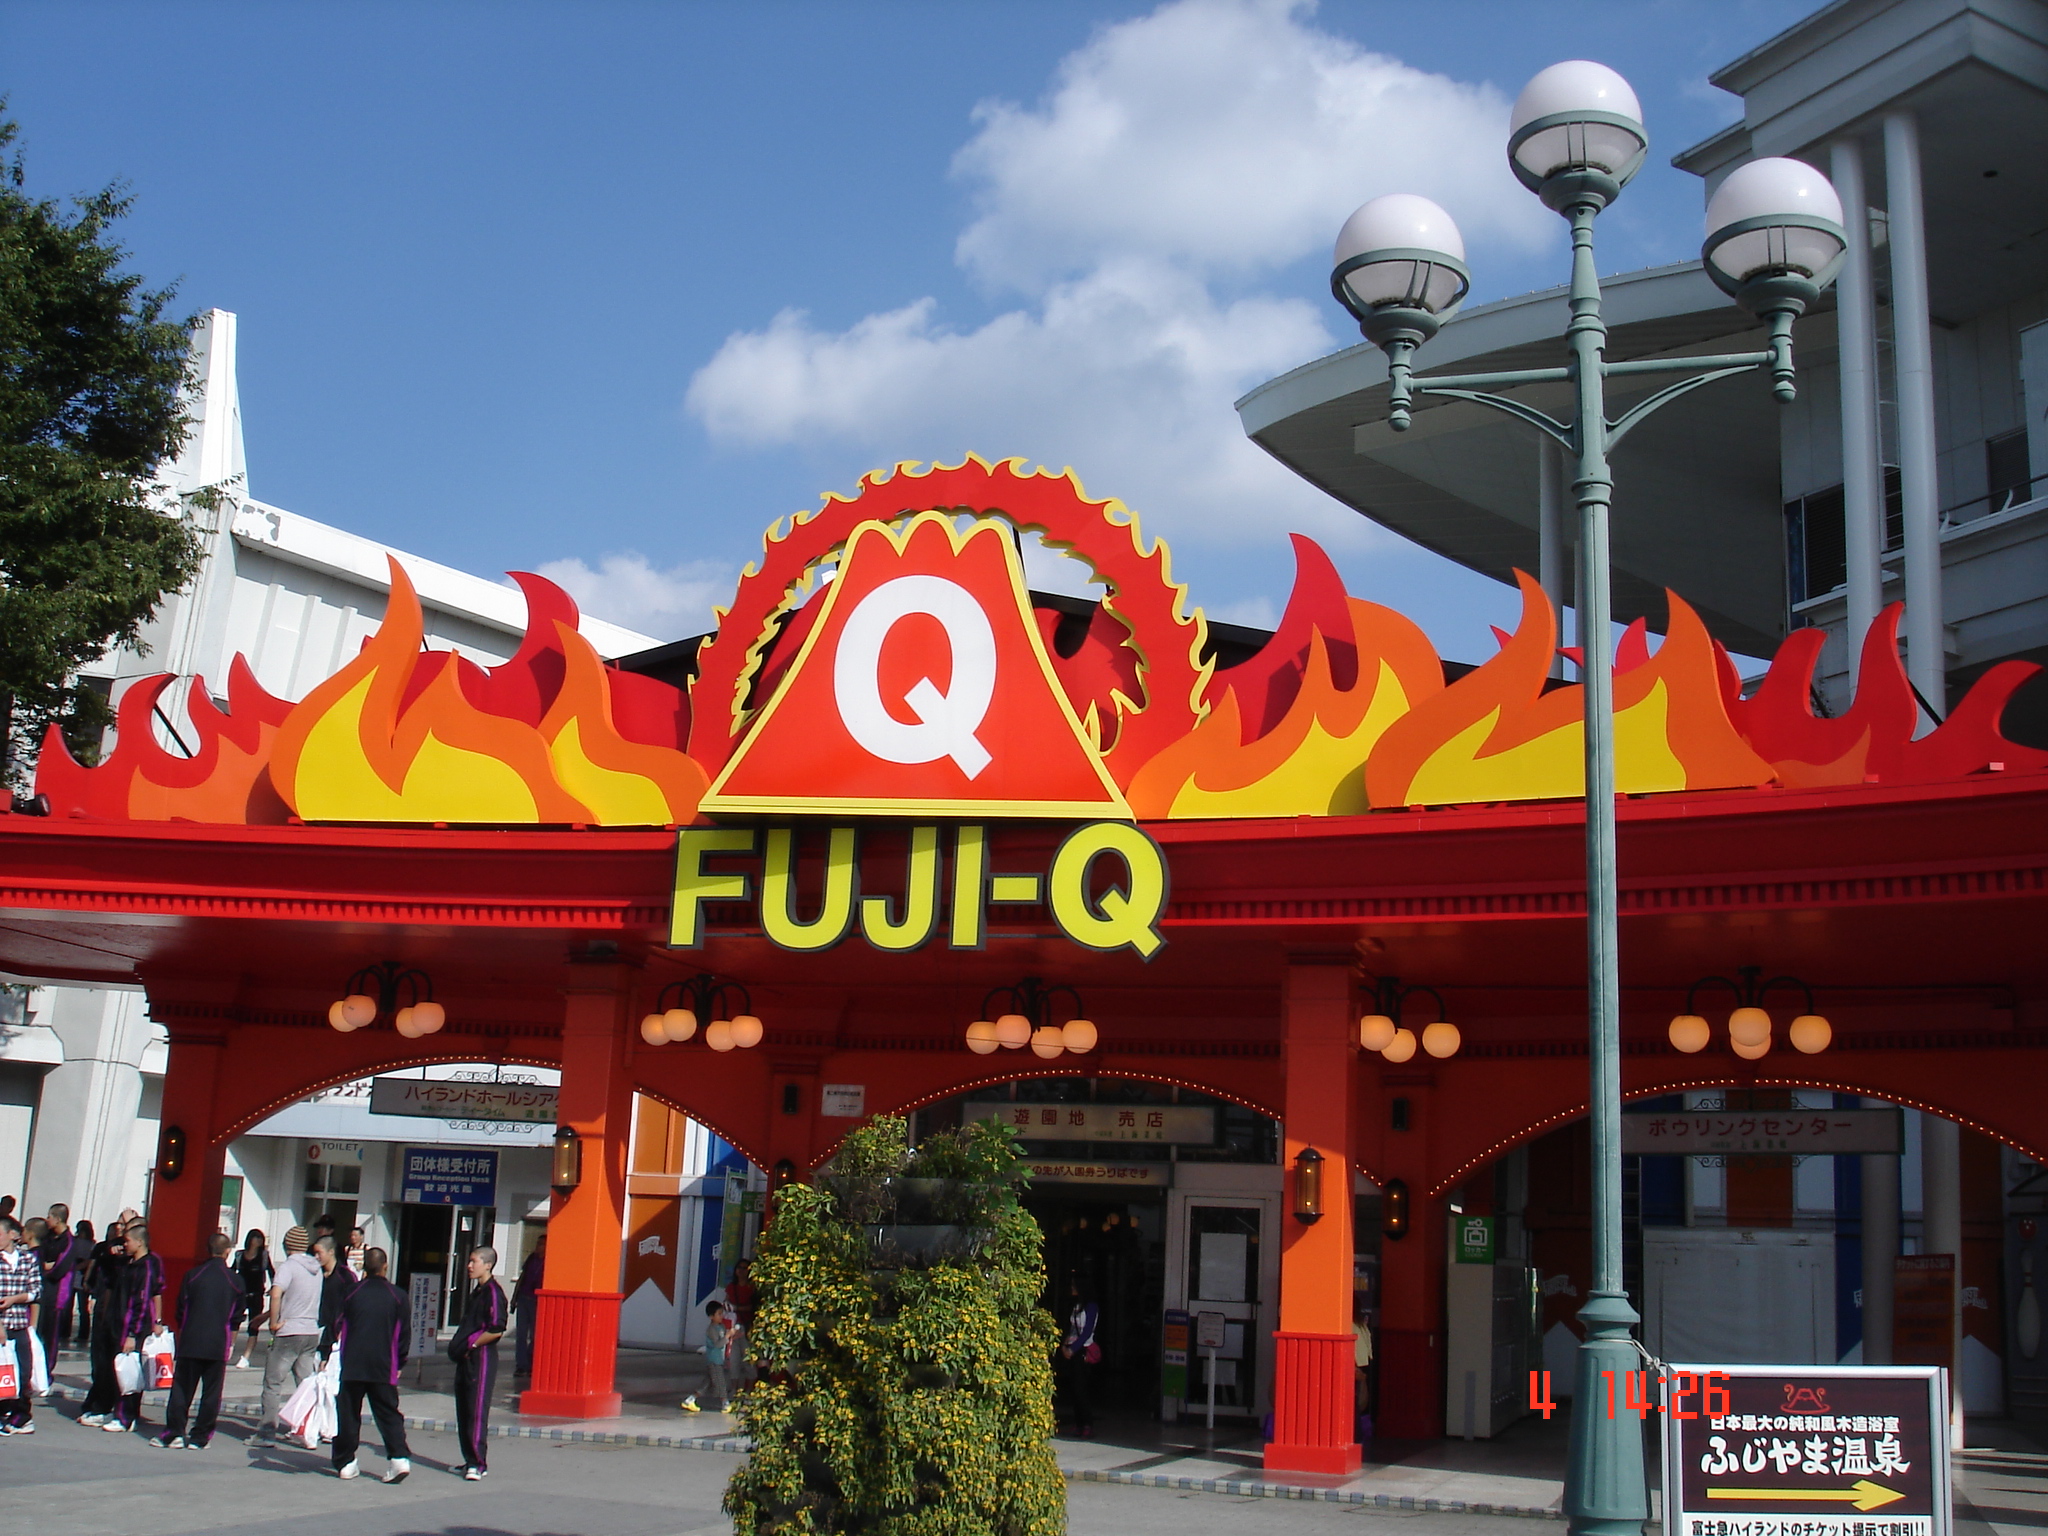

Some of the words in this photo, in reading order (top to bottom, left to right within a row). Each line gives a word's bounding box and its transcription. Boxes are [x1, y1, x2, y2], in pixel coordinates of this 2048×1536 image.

[834, 575, 996, 781] Q
[667, 821, 1170, 962] FUJI-Q
[1014, 1108, 1085, 1126] 遊園地
[1118, 1110, 1163, 1127] 売店
[1649, 1117, 1852, 1136] ボウリングセンター
[321, 1142, 359, 1152] TOILET
[410, 1156, 491, 1175] 団体様受付所
[1026, 1164, 1149, 1179] の先が入園券うりばです
[409, 1173, 431, 1182] Group
[432, 1174, 470, 1183] Reception
[471, 1175, 490, 1183] Desk
[1710, 1415, 1900, 1432] 日本最大の純和風木造浴室
[1701, 1433, 1911, 1477] ふじやま温泉
